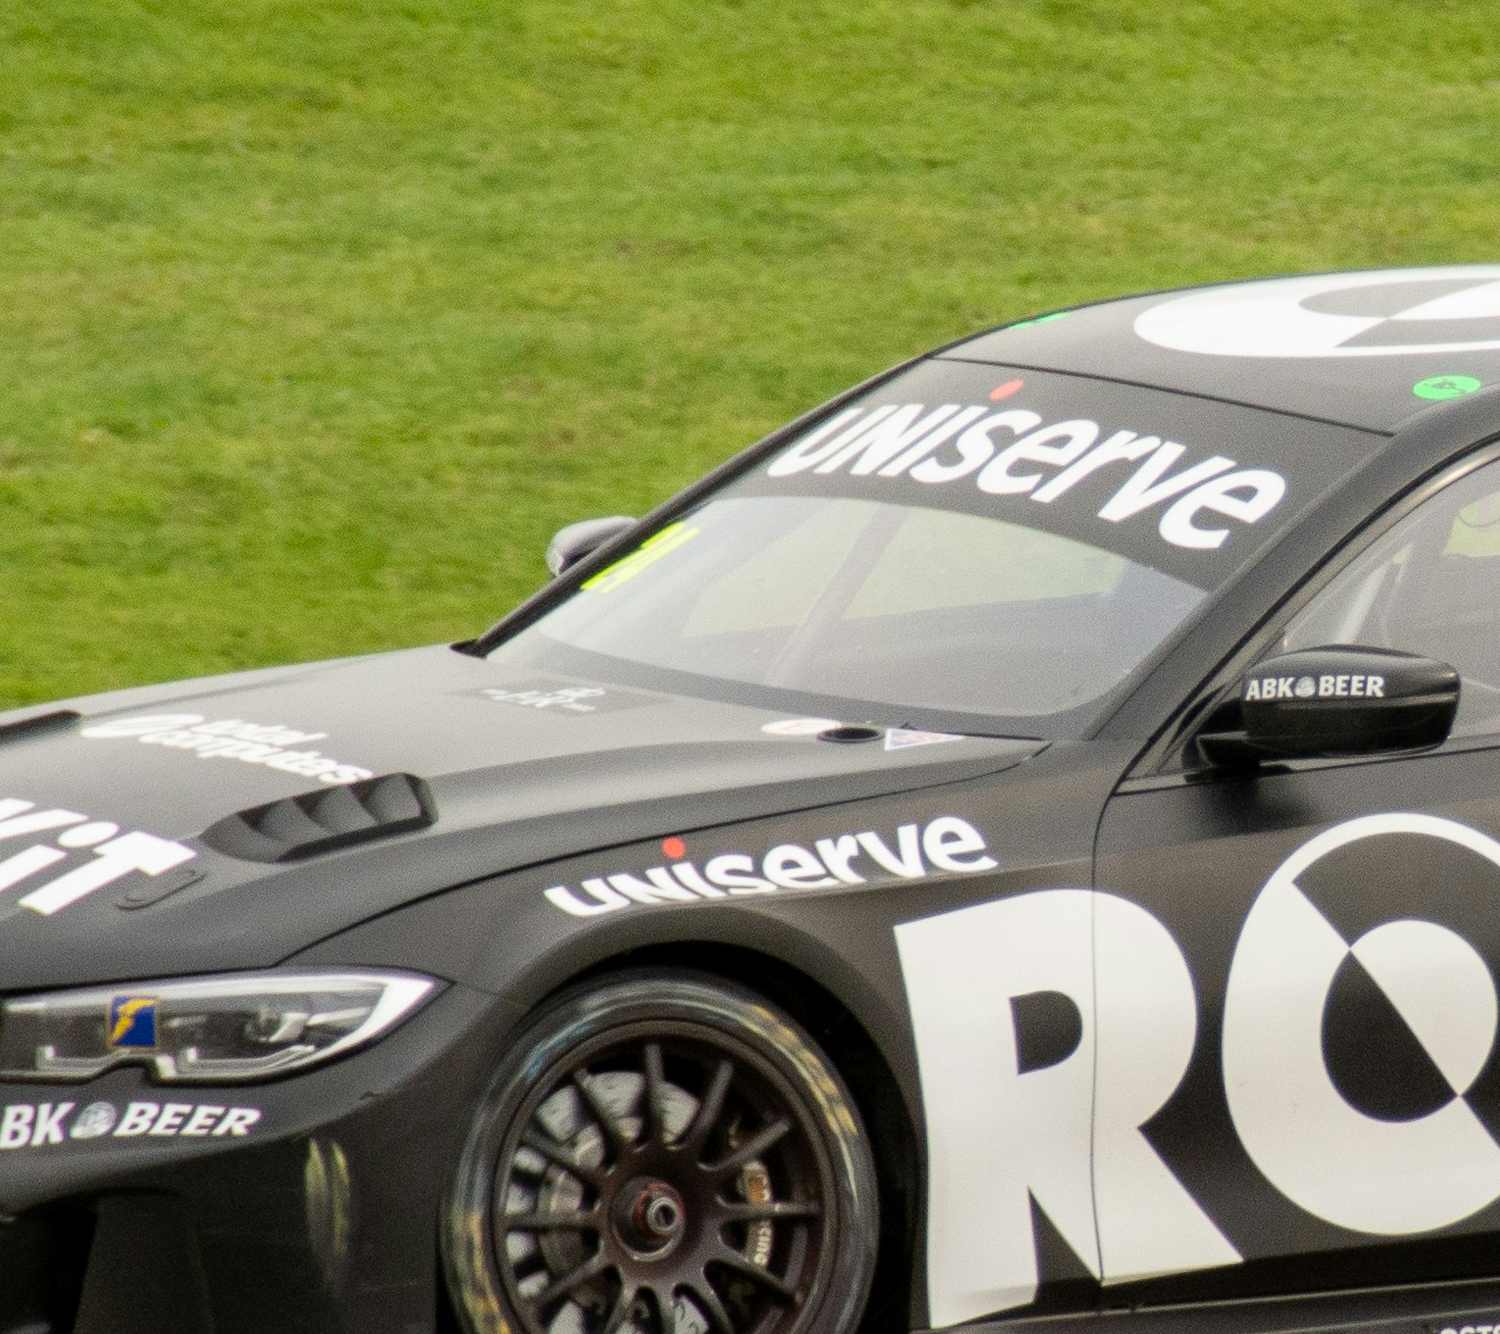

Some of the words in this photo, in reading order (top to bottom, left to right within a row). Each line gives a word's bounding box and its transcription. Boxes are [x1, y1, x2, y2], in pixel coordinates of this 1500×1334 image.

[1245, 677, 1295, 701] ABK
[1318, 675, 1385, 697] BEER
[190, 719, 328, 746] total
[138, 730, 374, 785] computers
[112, 1101, 261, 1138] BEER
